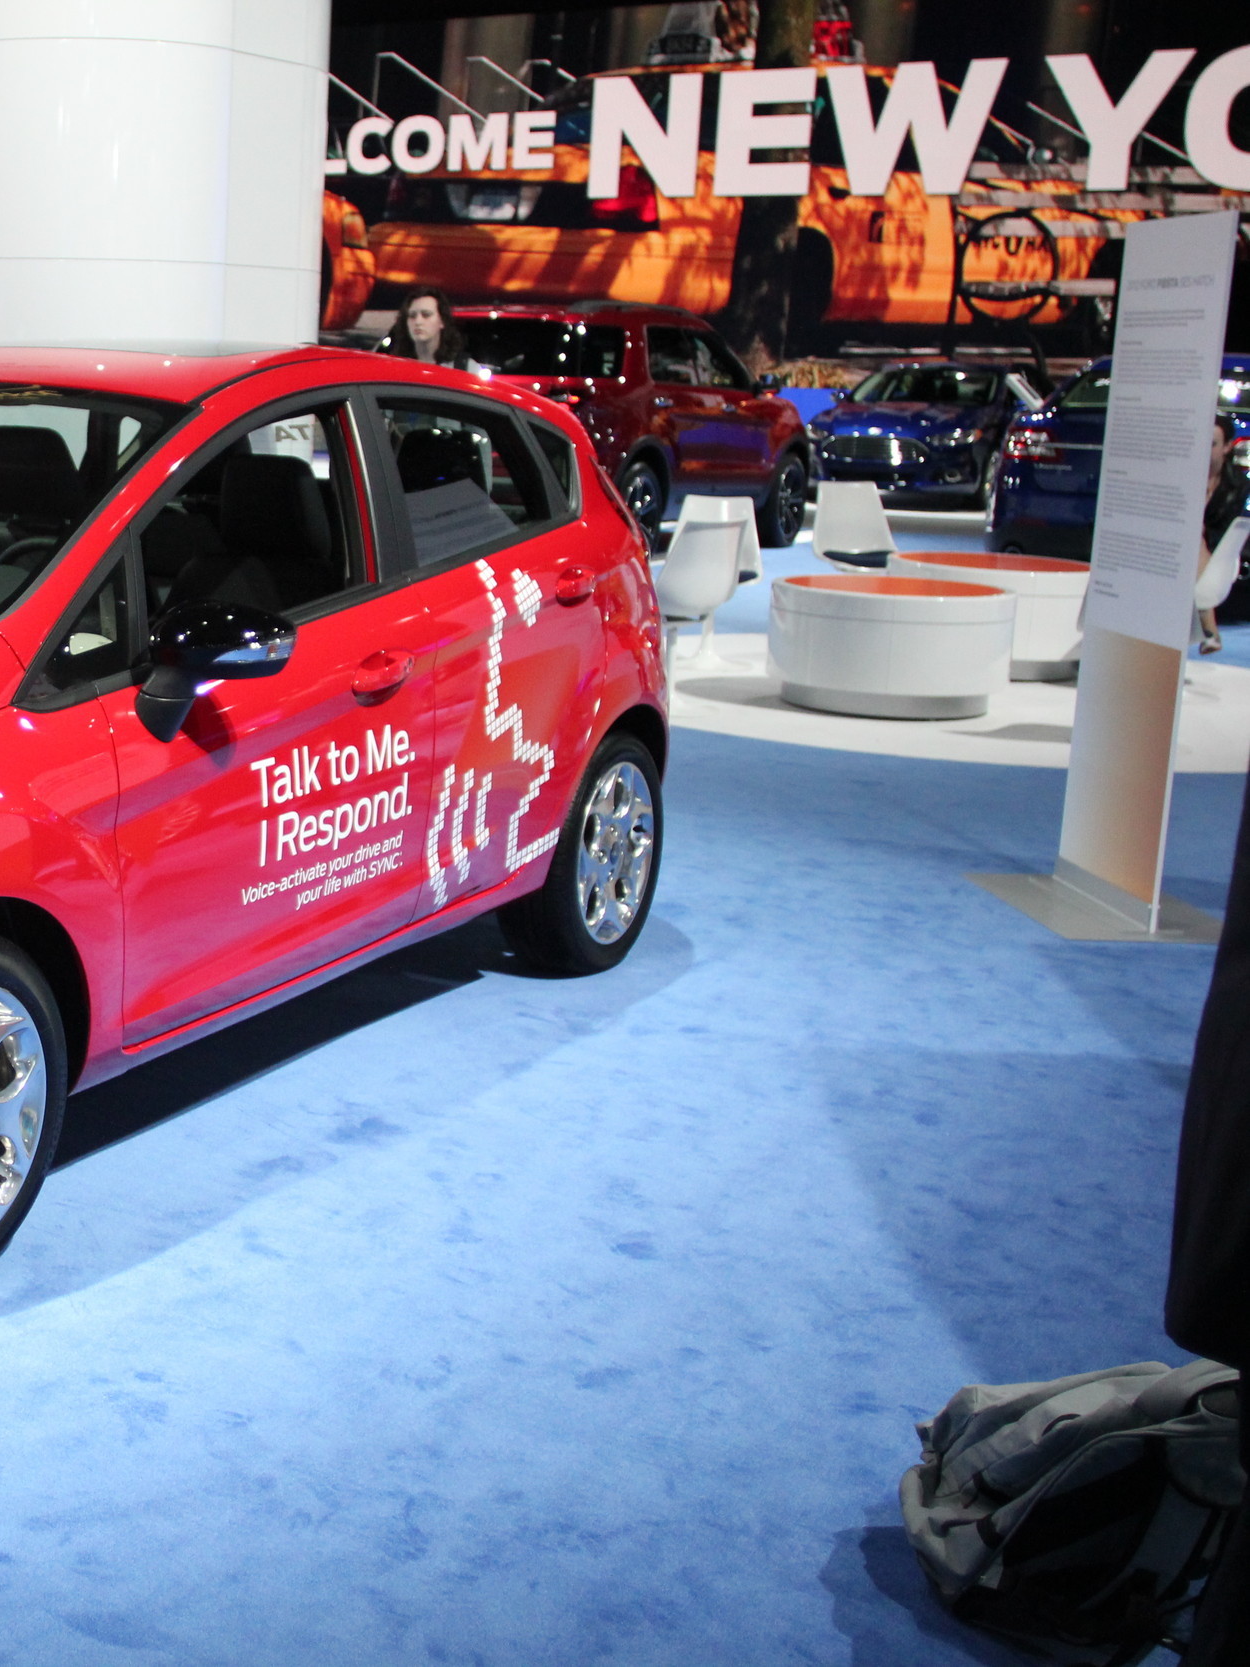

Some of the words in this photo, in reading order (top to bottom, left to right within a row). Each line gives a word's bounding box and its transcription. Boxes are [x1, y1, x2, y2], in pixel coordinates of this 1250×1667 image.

[587, 57, 1009, 199] NEW
[250, 745, 321, 808] Talk
[327, 741, 360, 785] to
[366, 724, 416, 775] Me.
[259, 820, 268, 867] I
[276, 772, 413, 861] Respond.
[241, 862, 327, 905] Voice-activate
[328, 853, 355, 877] your
[354, 841, 380, 864] drive
[382, 830, 404, 850] and
[296, 884, 324, 911] your
[323, 876, 341, 896] life
[343, 867, 367, 887] with
